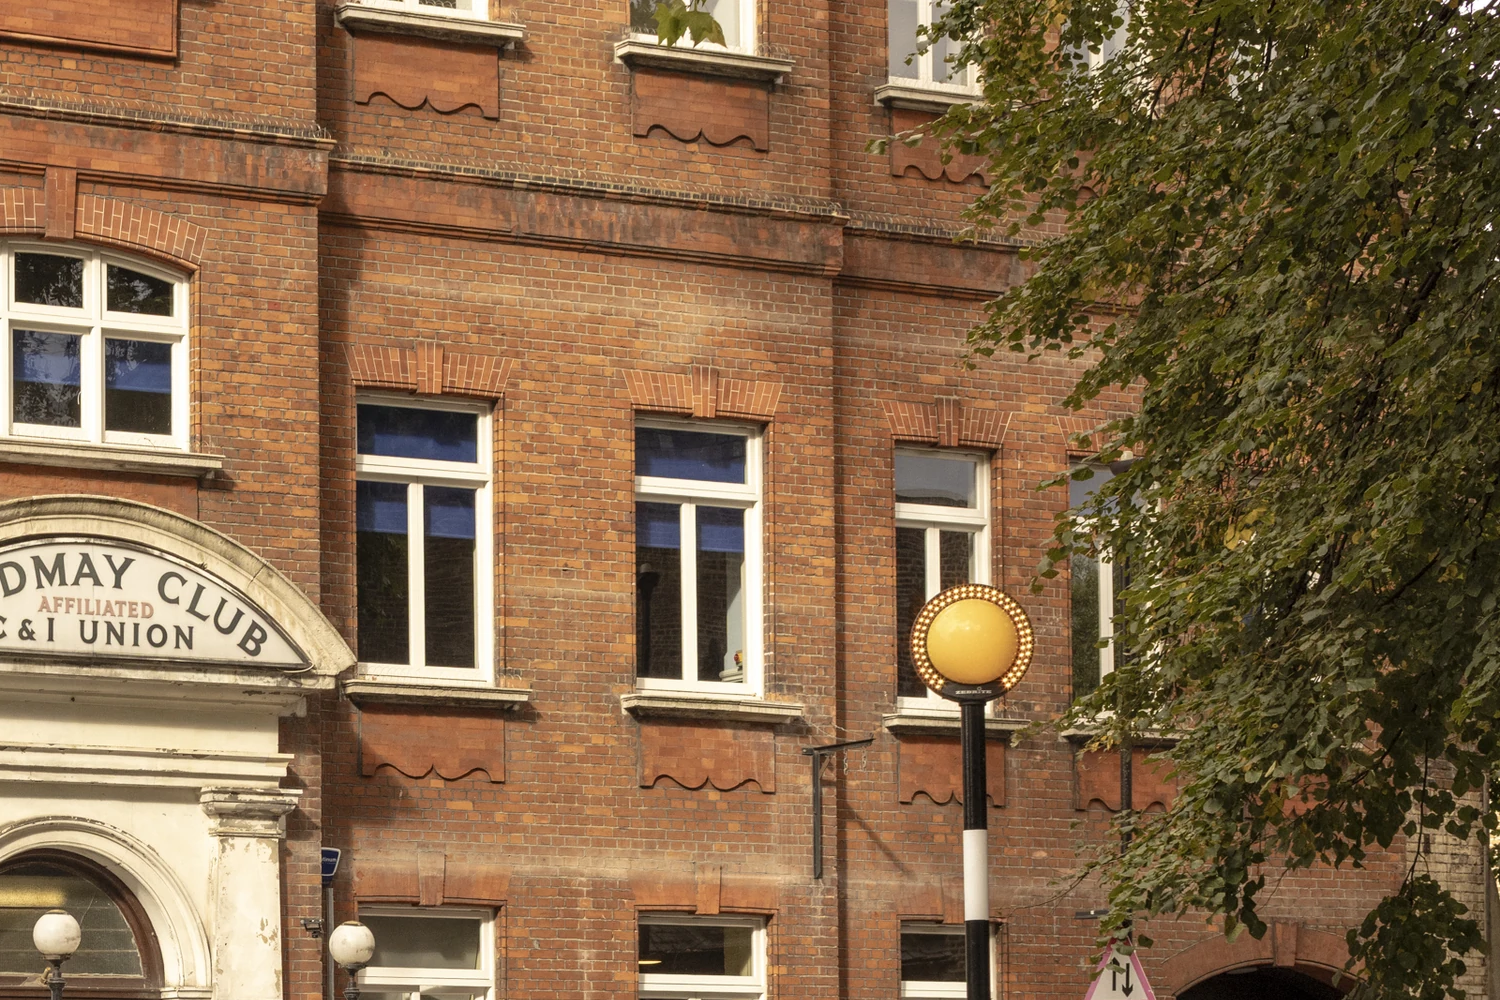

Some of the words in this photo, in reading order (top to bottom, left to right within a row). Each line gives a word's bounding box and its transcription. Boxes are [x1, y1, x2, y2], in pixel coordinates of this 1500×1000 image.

[38, 595, 154, 619] AFFILIATED
[157, 570, 269, 658] CLUB
[17, 619, 36, 641] &
[47, 617, 56, 642] I
[79, 620, 195, 650] UNION
